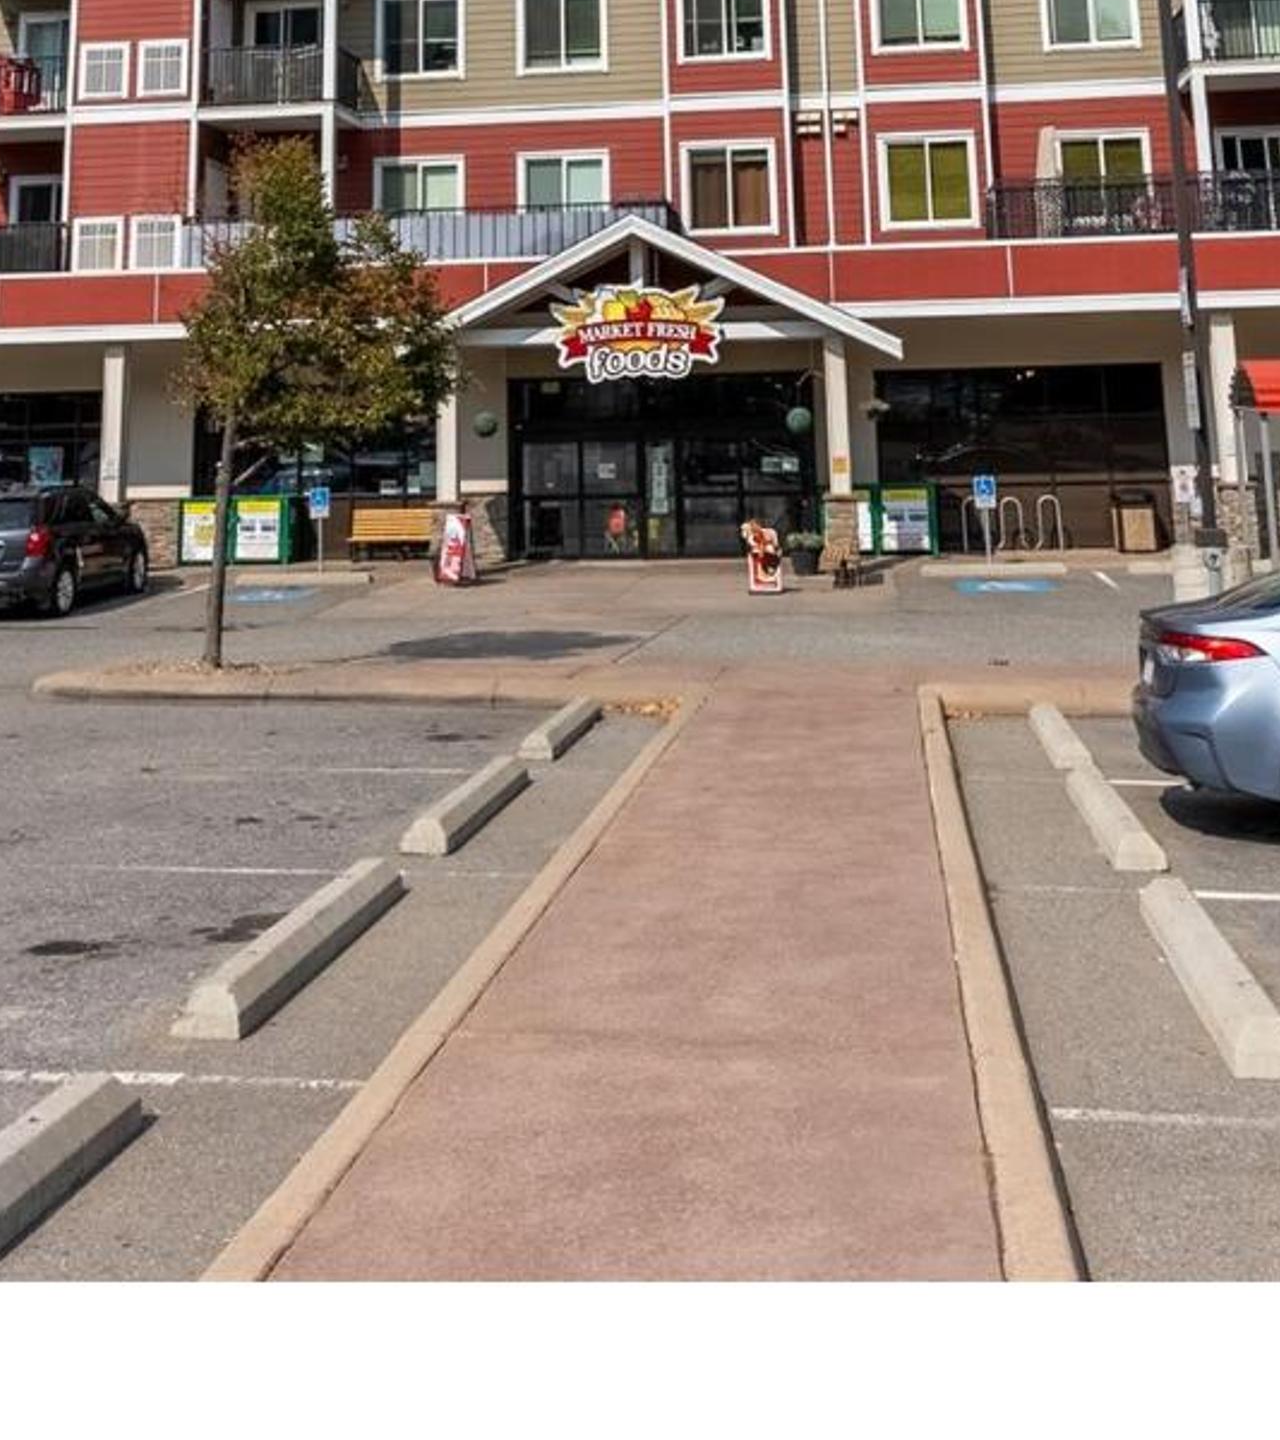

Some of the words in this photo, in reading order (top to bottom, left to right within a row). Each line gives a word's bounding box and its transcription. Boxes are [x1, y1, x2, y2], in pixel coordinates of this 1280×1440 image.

[578, 323, 643, 341] MARKET
[647, 324, 696, 339] FRESH
[589, 345, 690, 380] foods
